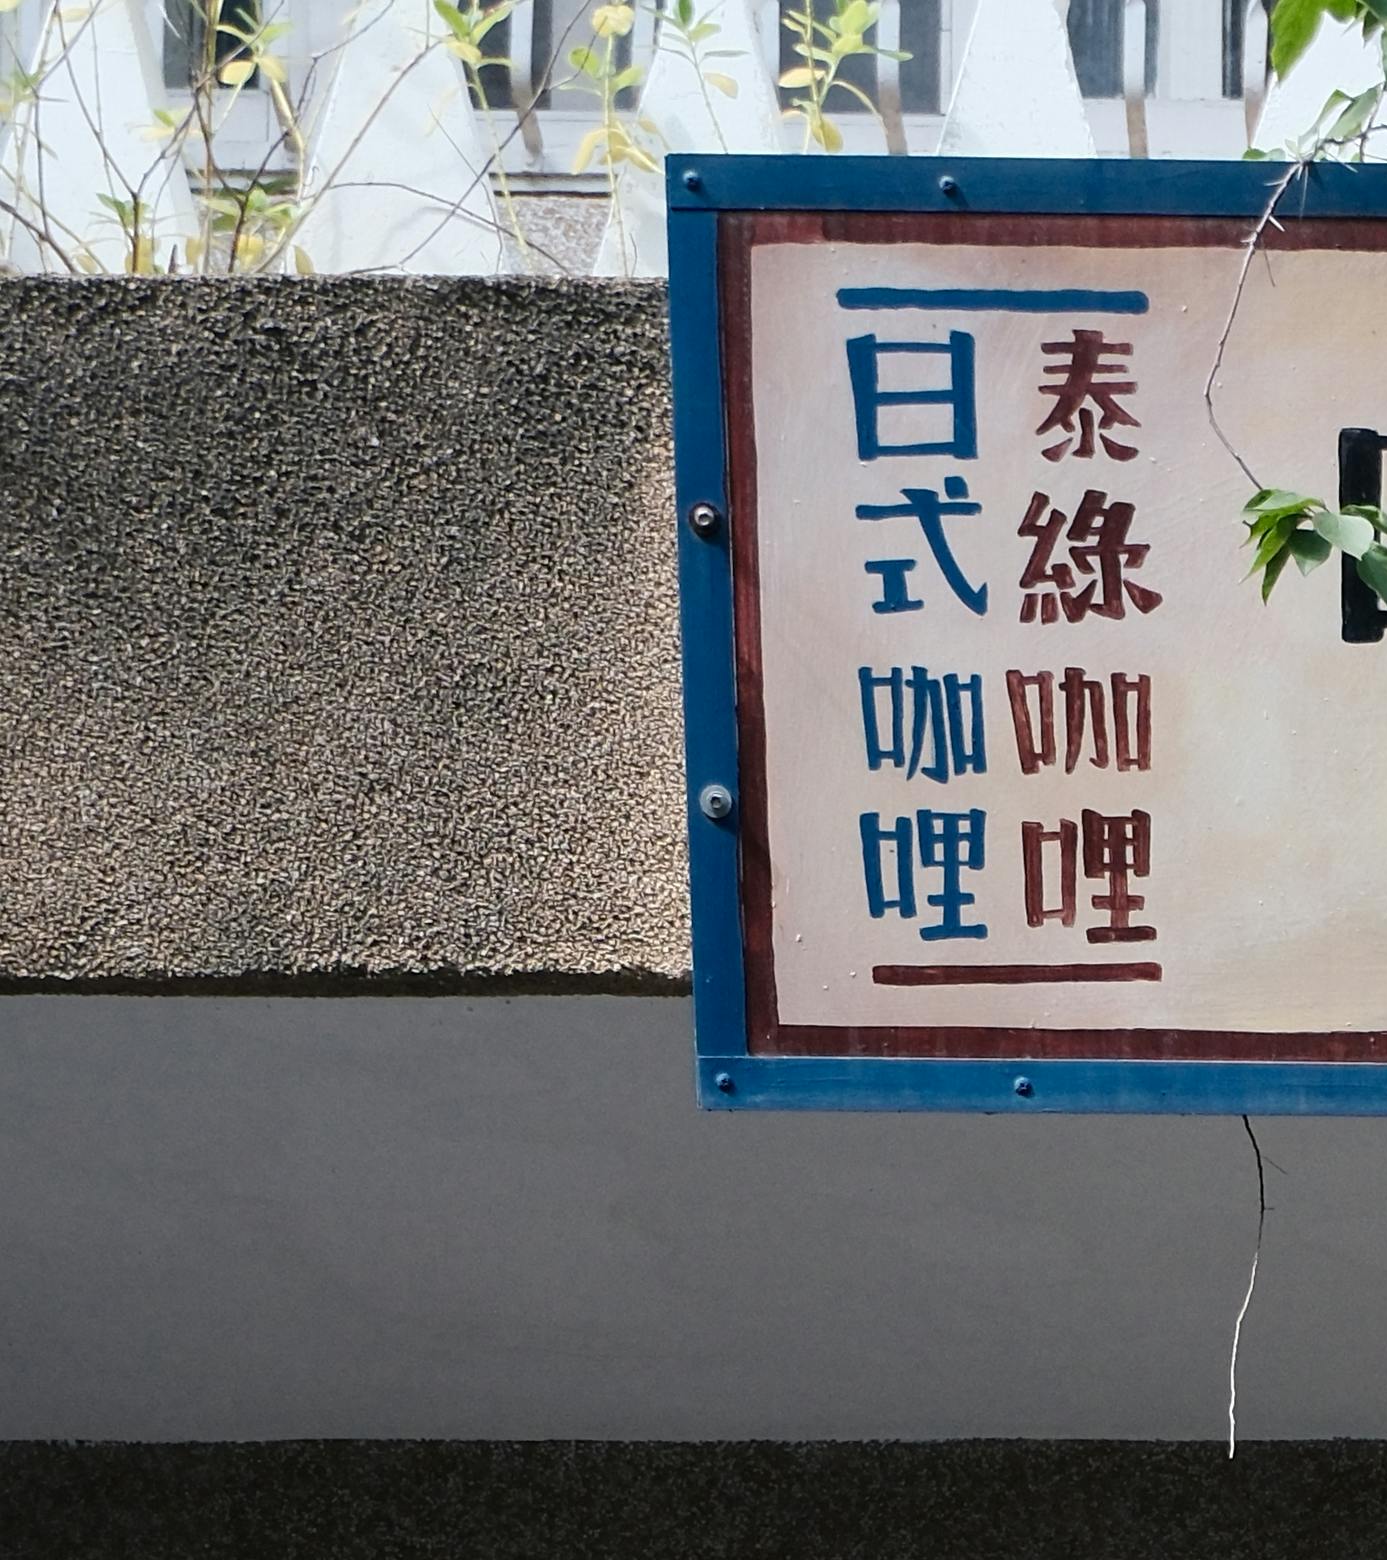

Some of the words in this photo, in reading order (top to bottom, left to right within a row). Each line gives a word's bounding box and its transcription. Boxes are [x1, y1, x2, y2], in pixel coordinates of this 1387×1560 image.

[846, 331, 989, 941] 日式咖哩
[1005, 328, 1163, 942] 泰綠咖哩
